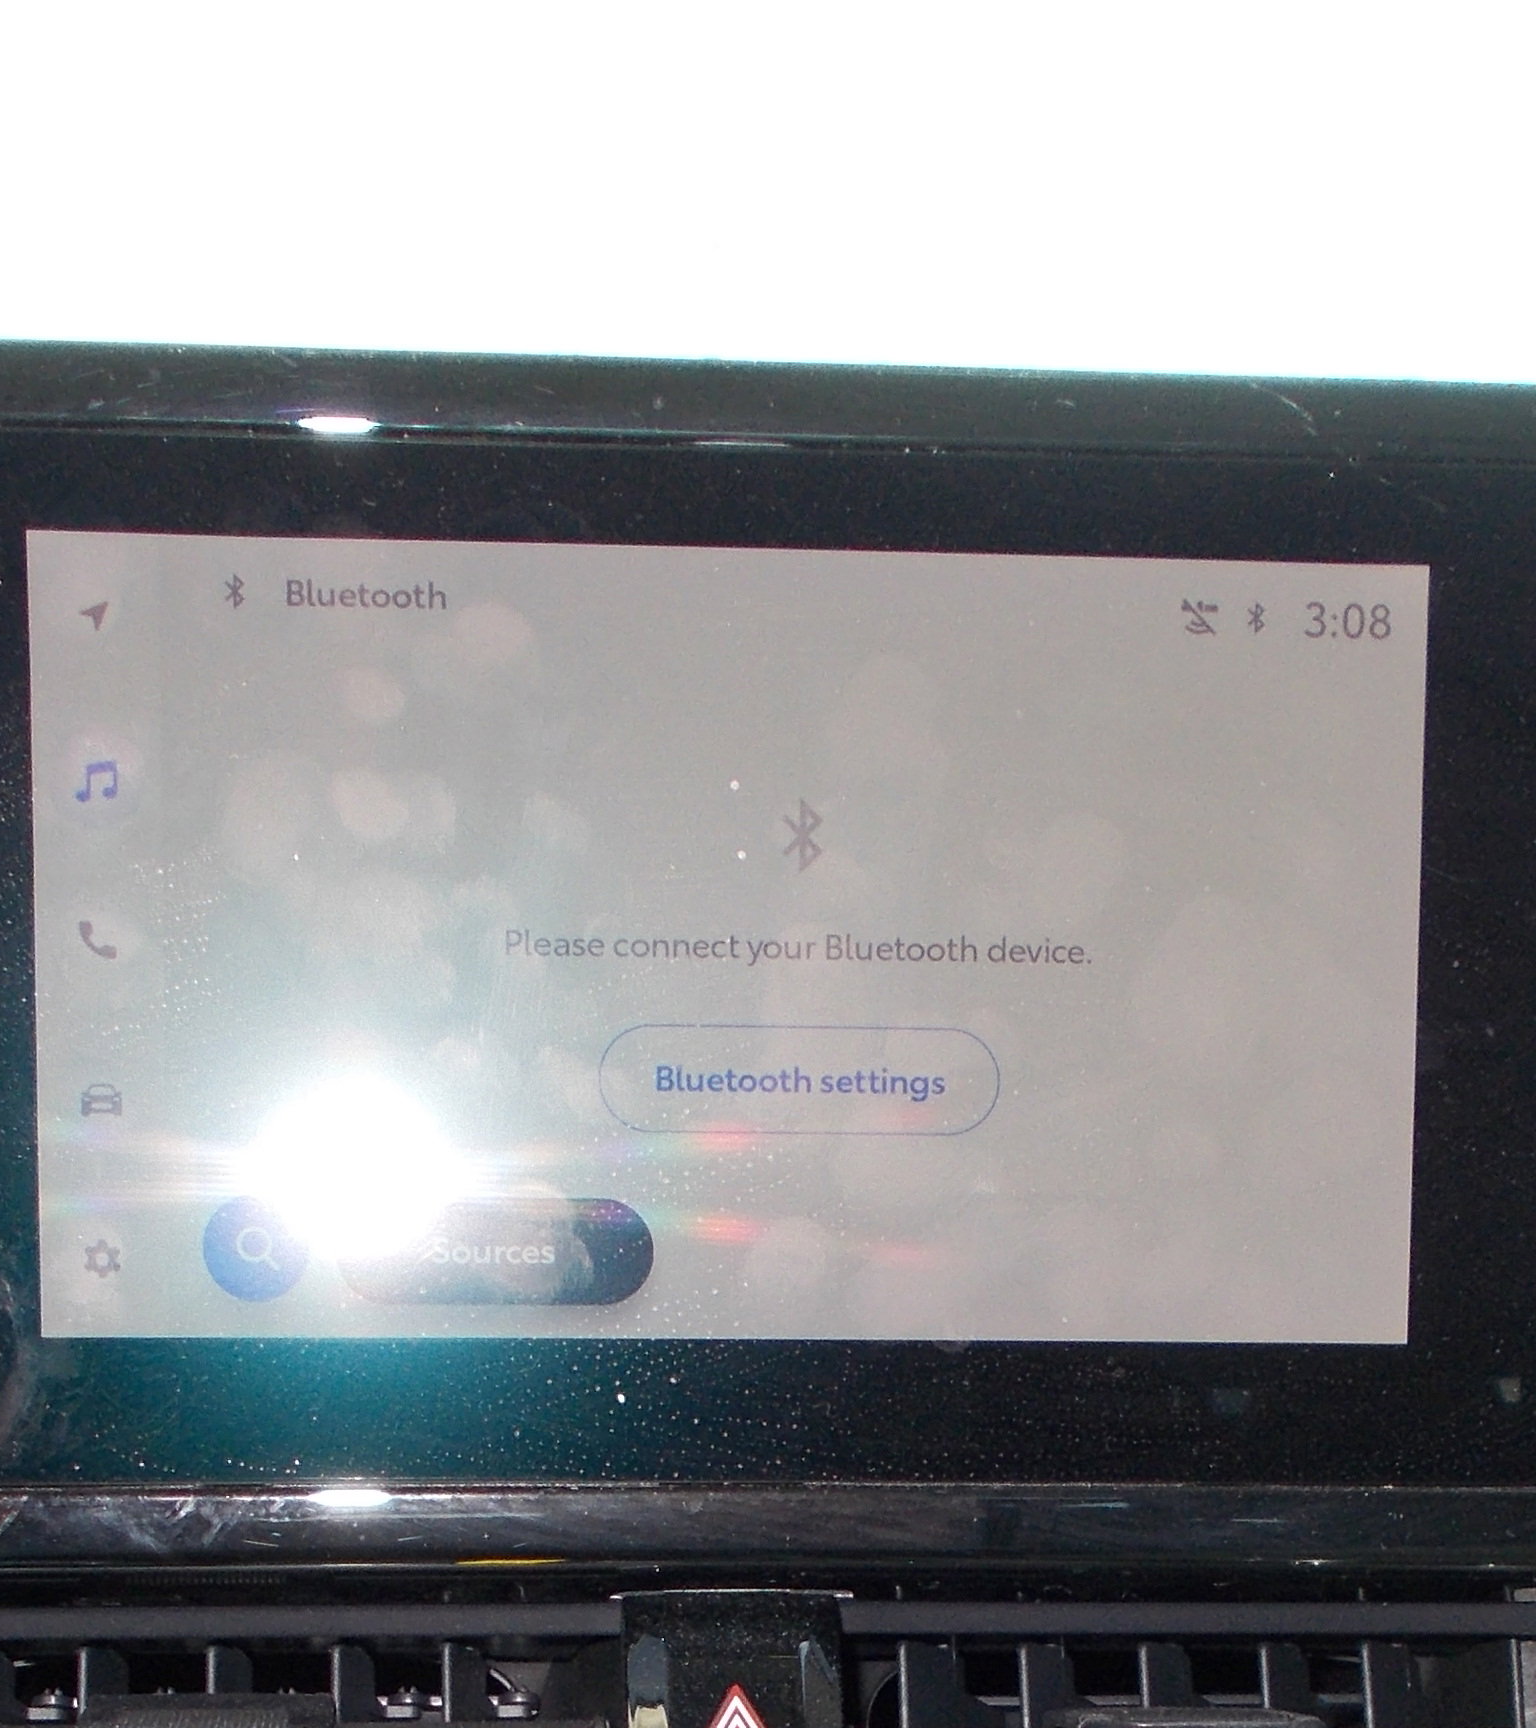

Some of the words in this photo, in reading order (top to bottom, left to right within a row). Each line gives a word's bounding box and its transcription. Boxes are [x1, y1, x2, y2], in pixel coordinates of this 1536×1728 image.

[286, 577, 447, 611] Bluetooth
[1304, 601, 1393, 641] 3:08
[504, 929, 605, 960] Please
[613, 934, 740, 961] connect
[746, 939, 817, 967] your
[825, 933, 978, 963] Bluetooth
[986, 935, 1093, 965] device.
[655, 1064, 812, 1095] Bluetooth
[820, 1069, 946, 1103] settings
[431, 1237, 556, 1265] Sources
